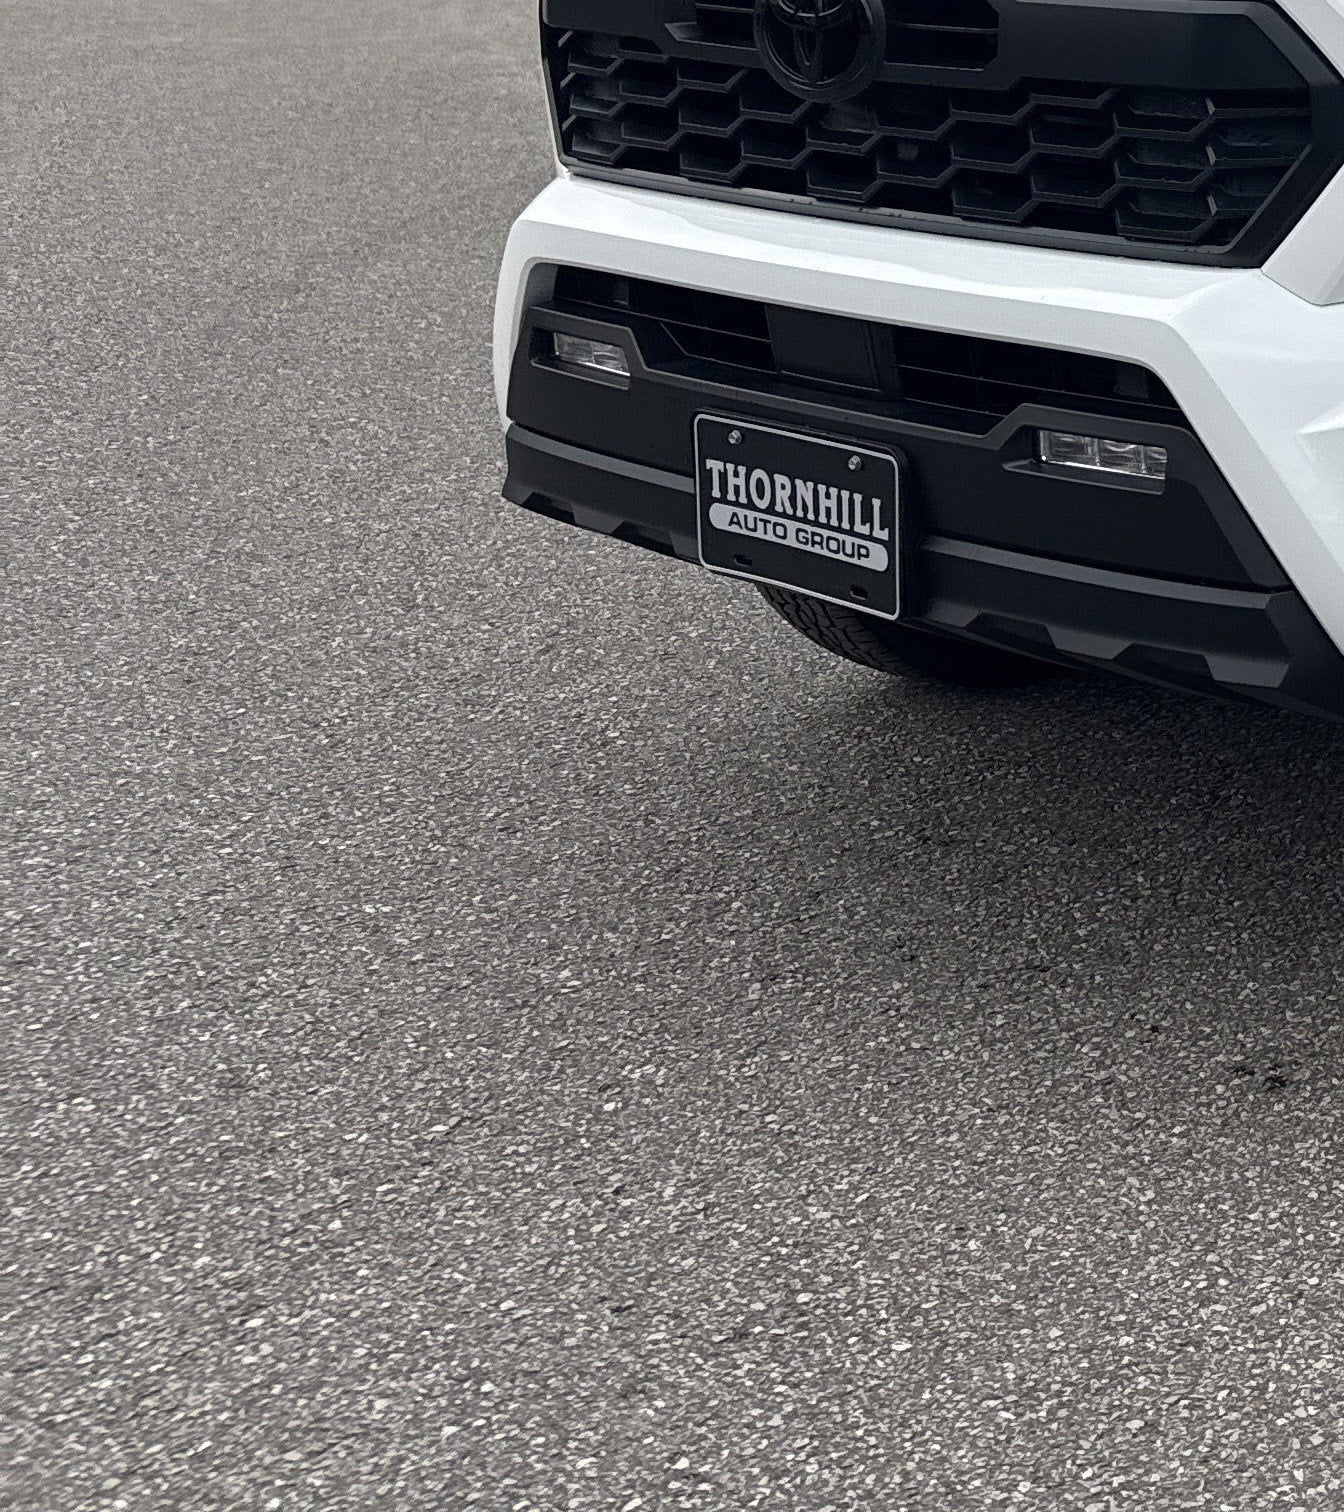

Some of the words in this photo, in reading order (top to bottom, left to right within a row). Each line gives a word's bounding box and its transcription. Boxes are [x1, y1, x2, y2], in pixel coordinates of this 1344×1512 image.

[705, 458, 890, 541] THORNHILL
[728, 511, 788, 541] AUTO
[795, 527, 871, 562] GROUP
